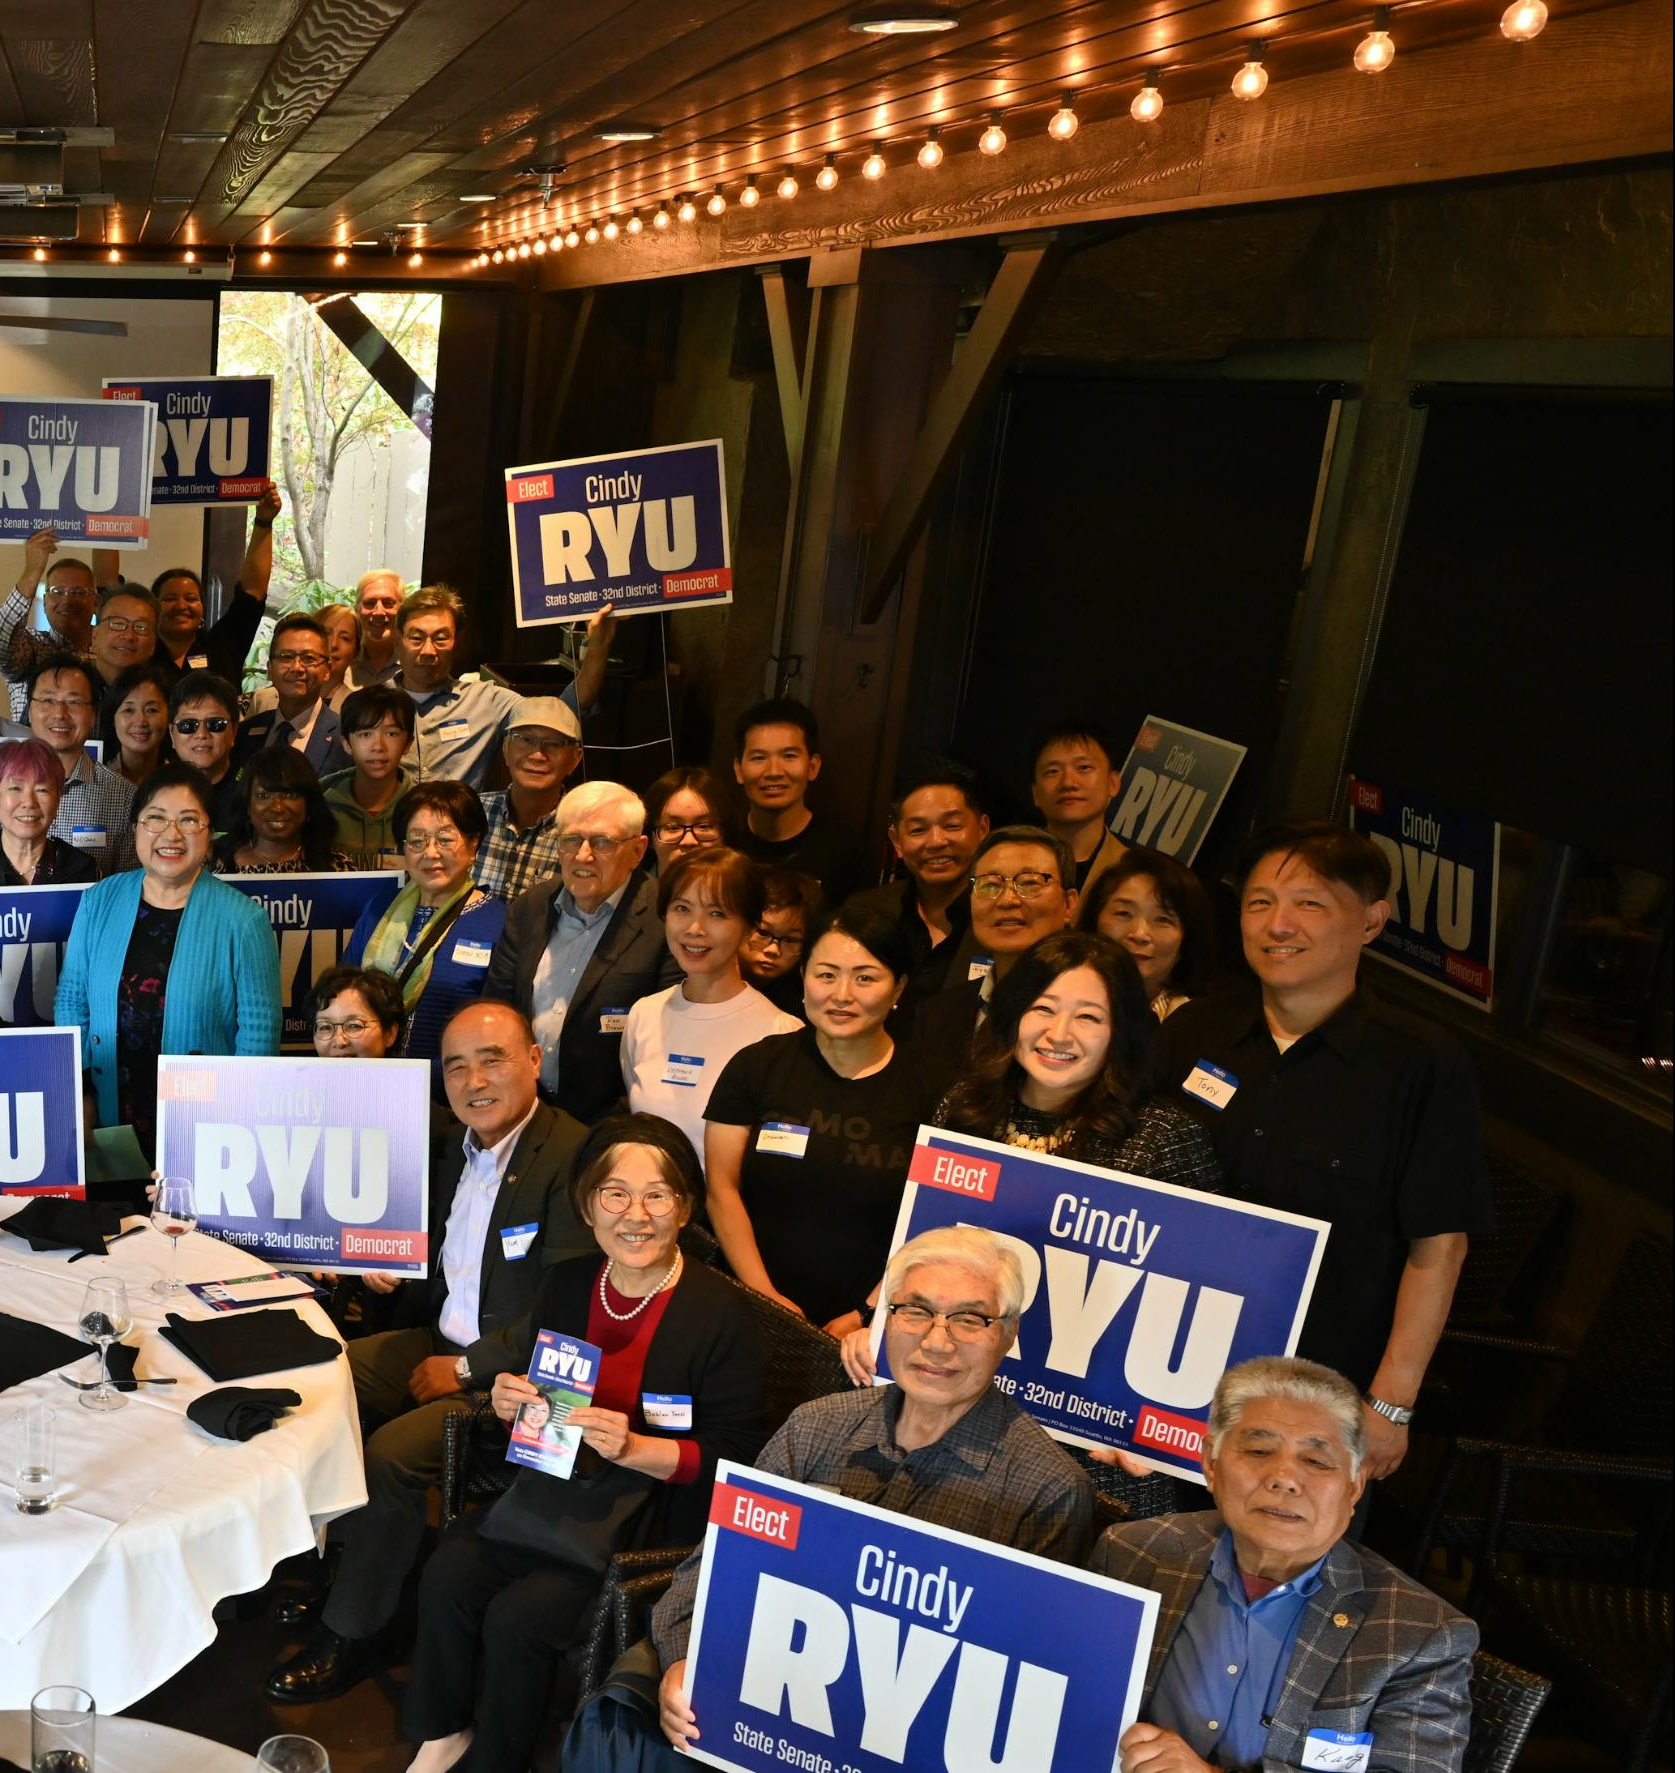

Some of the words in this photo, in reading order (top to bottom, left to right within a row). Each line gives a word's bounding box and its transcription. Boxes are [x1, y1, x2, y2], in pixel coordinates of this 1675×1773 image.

[166, 391, 212, 417] Cindy
[28, 415, 78, 444] Cindy
[172, 485, 189, 494] 32nd
[190, 484, 215, 494] District
[221, 482, 261, 494] Democrat
[518, 481, 548, 499] Elect
[585, 470, 642, 503] Cindy
[3, 518, 29, 529] Senate
[33, 519, 52, 529] 32nd
[53, 520, 82, 531] District
[88, 521, 133, 533] Democrat
[539, 495, 697, 586] RYU
[545, 593, 568, 607] State
[569, 591, 598, 605] Senate
[602, 587, 624, 600] 32nd
[625, 583, 658, 597] District
[666, 573, 719, 593] Democrat
[1164, 744, 1198, 781] Cindy
[1109, 766, 1208, 857] RYU
[1358, 786, 1379, 810] Elect
[1402, 806, 1442, 852] Cindy
[1446, 957, 1483, 988] Democrat
[1197, 1077, 1220, 1098] Tony
[194, 1122, 389, 1224] RYU
[933, 1156, 989, 1193] Elect
[222, 1230, 259, 1246] Senate
[263, 1233, 291, 1248] 32nd
[293, 1233, 334, 1250] District
[345, 1235, 413, 1256] Democrat
[1049, 1193, 1161, 1266] Cindy
[538, 1347, 592, 1382] RYU
[994, 1374, 1016, 1396] ate
[1024, 1382, 1063, 1410] 32nd
[1067, 1395, 1127, 1429] District
[1142, 1414, 1205, 1453] Demo
[732, 1496, 790, 1541] Elect
[855, 1544, 975, 1632] Cindy
[739, 1572, 1069, 1773] RYU
[733, 1721, 773, 1755] State
[777, 1739, 832, 1773] Senate
